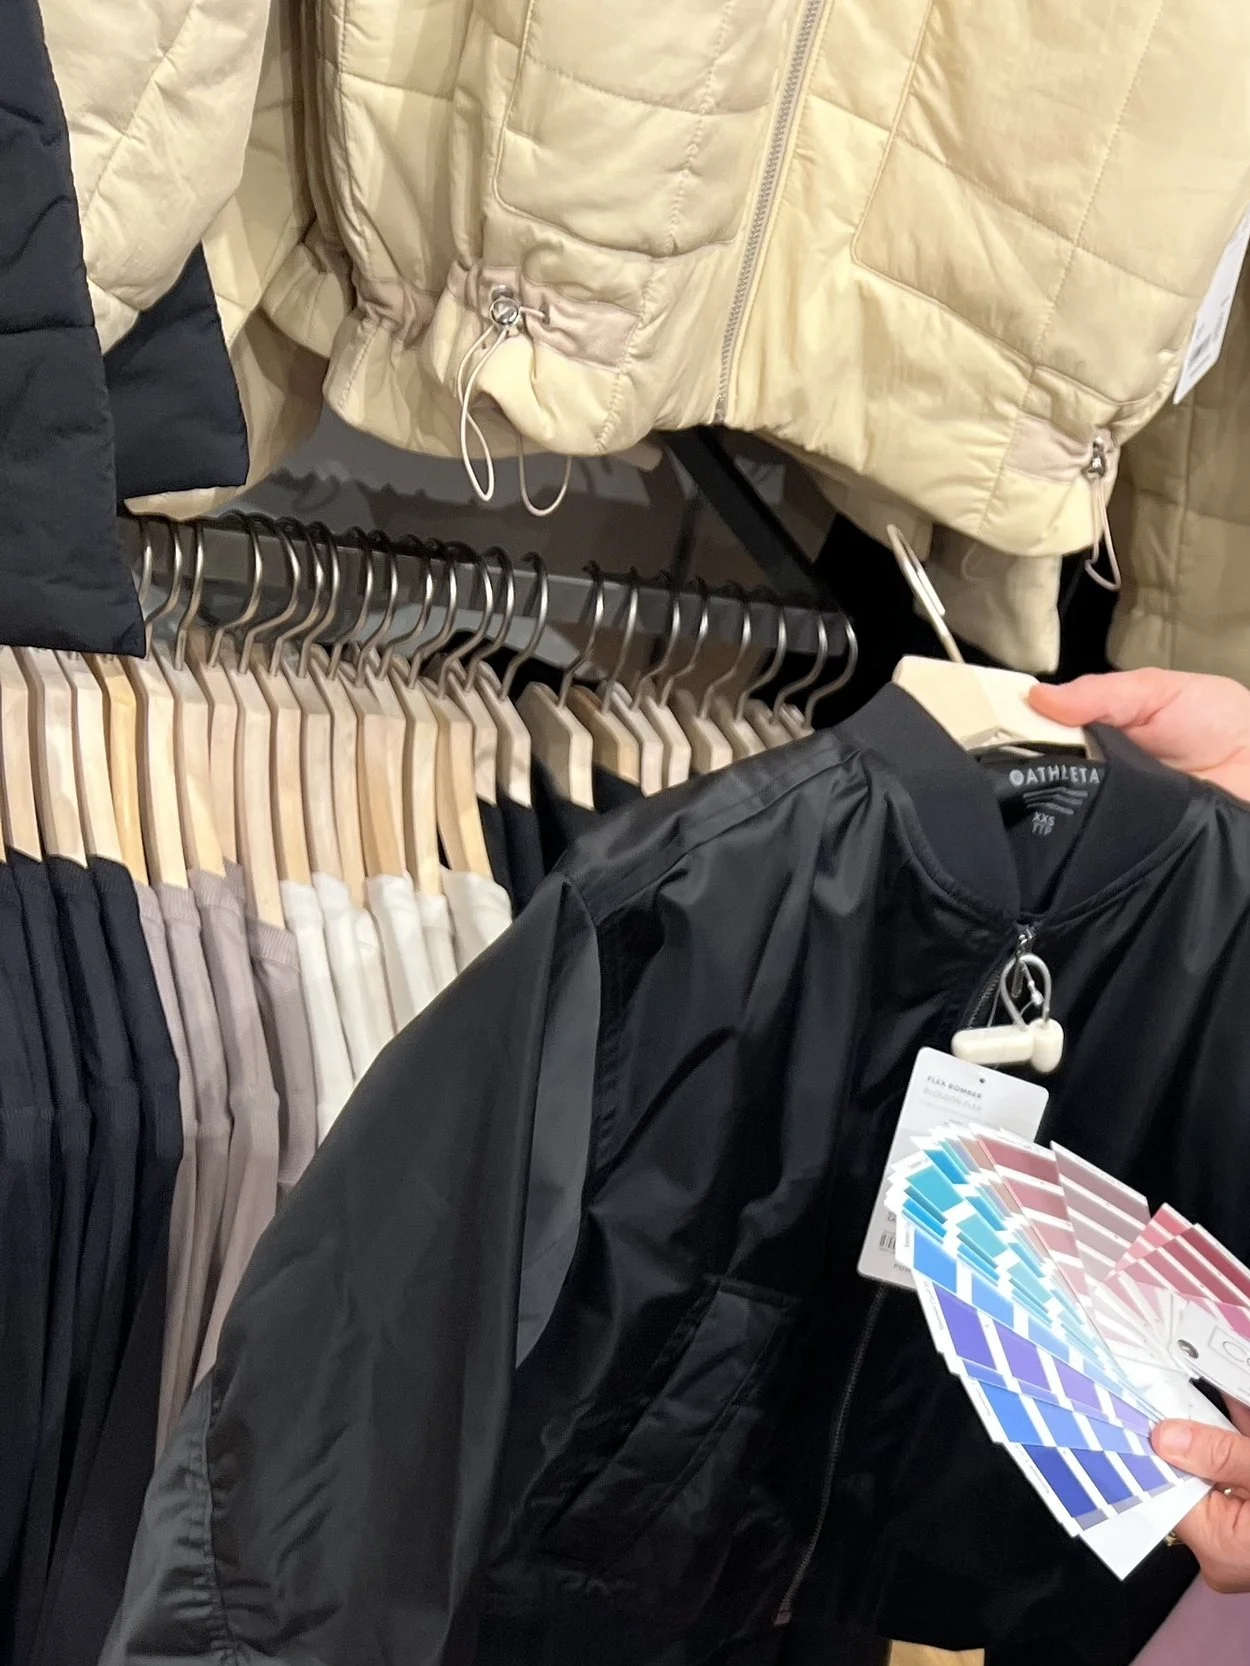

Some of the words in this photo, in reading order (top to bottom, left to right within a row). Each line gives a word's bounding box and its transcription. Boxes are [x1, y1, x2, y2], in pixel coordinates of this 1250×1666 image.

[1026, 765, 1100, 785] ATHLETA
[1032, 811, 1055, 826] XXS
[948, 1084, 982, 1098] BOMBER
